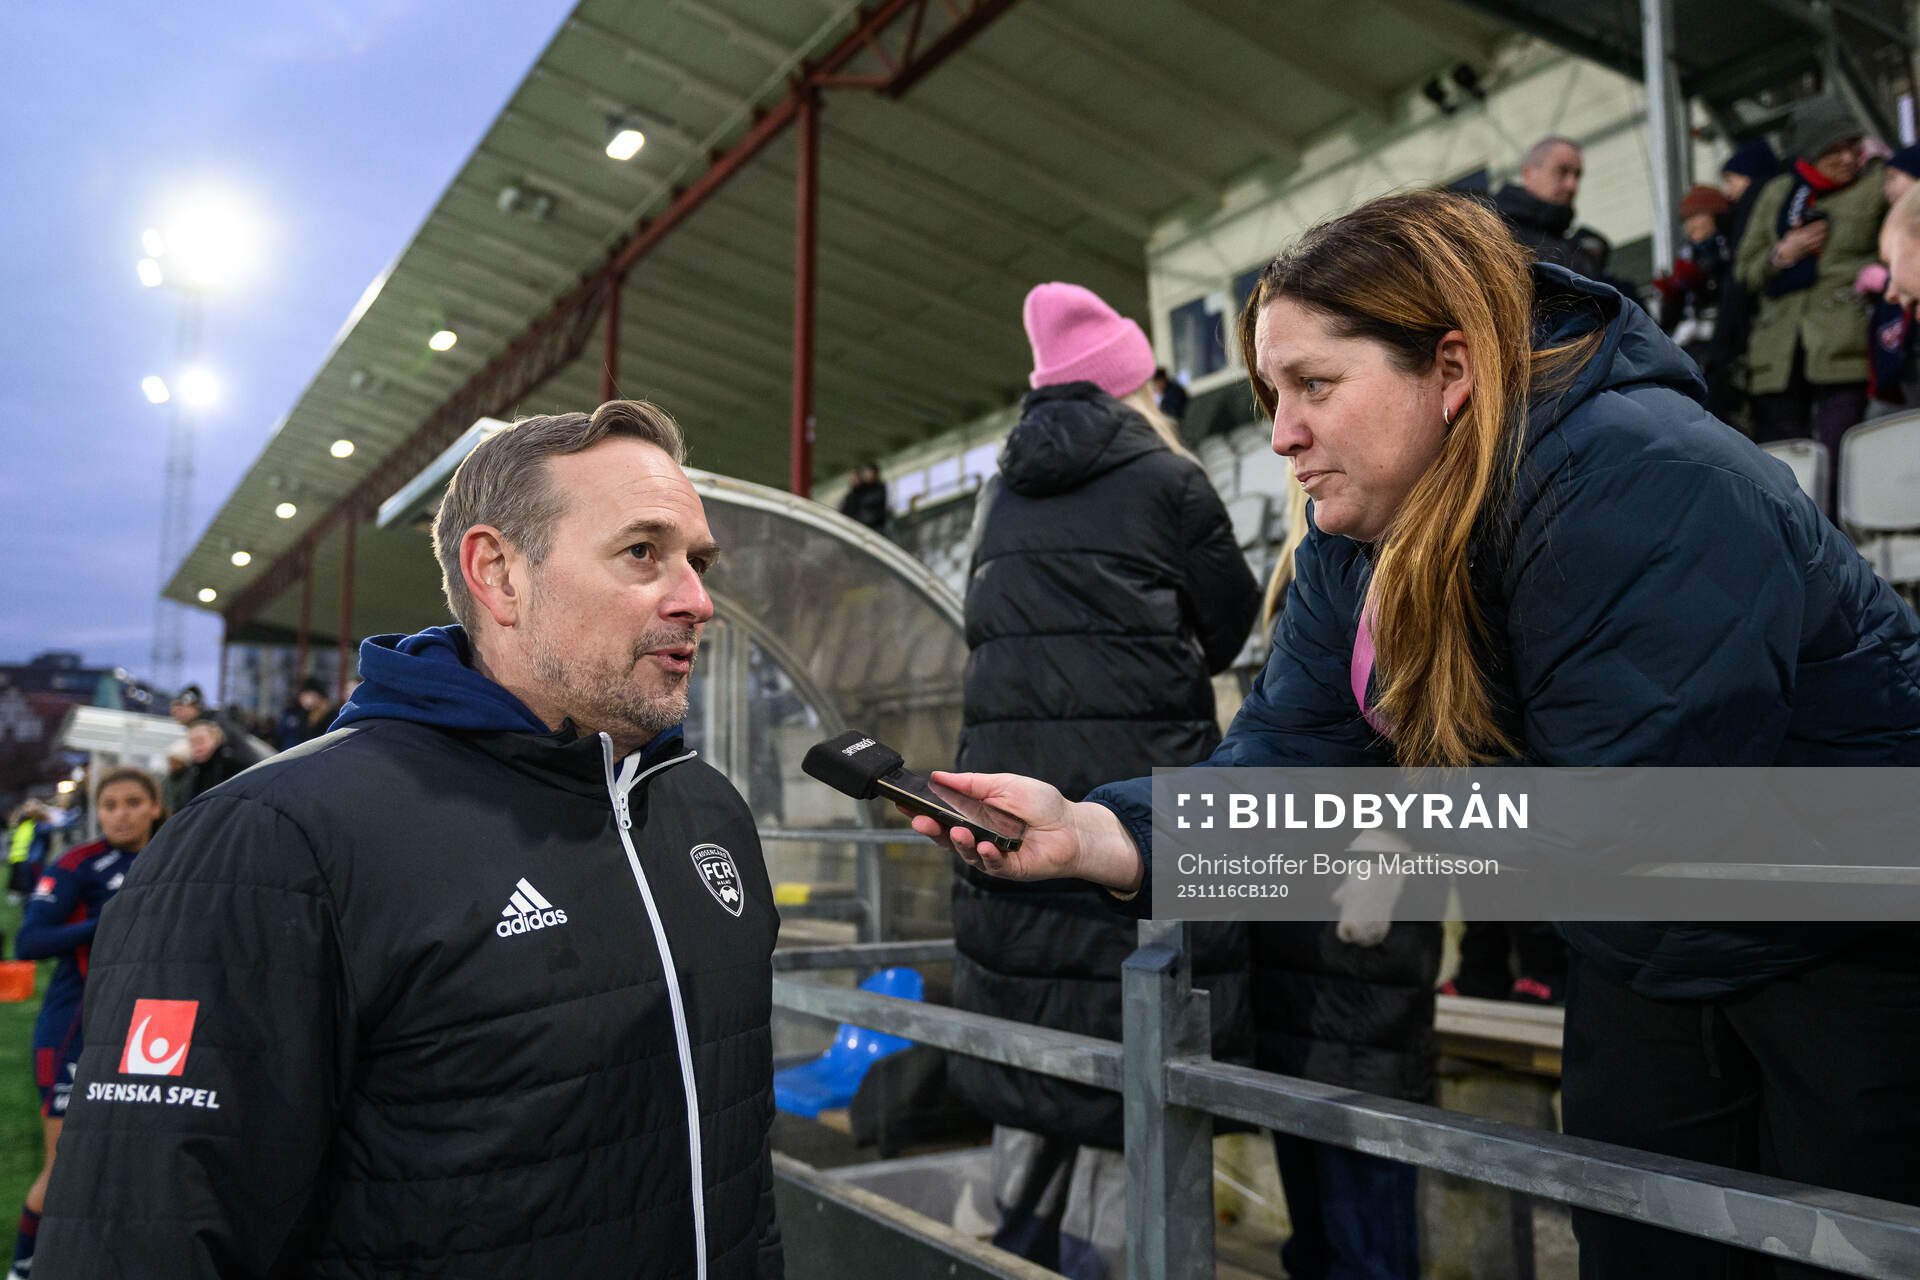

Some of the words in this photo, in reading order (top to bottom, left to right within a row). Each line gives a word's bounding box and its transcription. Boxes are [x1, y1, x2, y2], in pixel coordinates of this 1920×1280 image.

[701, 861, 735, 881] FCR
[496, 909, 568, 938] adidas
[86, 1082, 162, 1103] SVENSKA
[165, 1085, 220, 1109] SPEL
